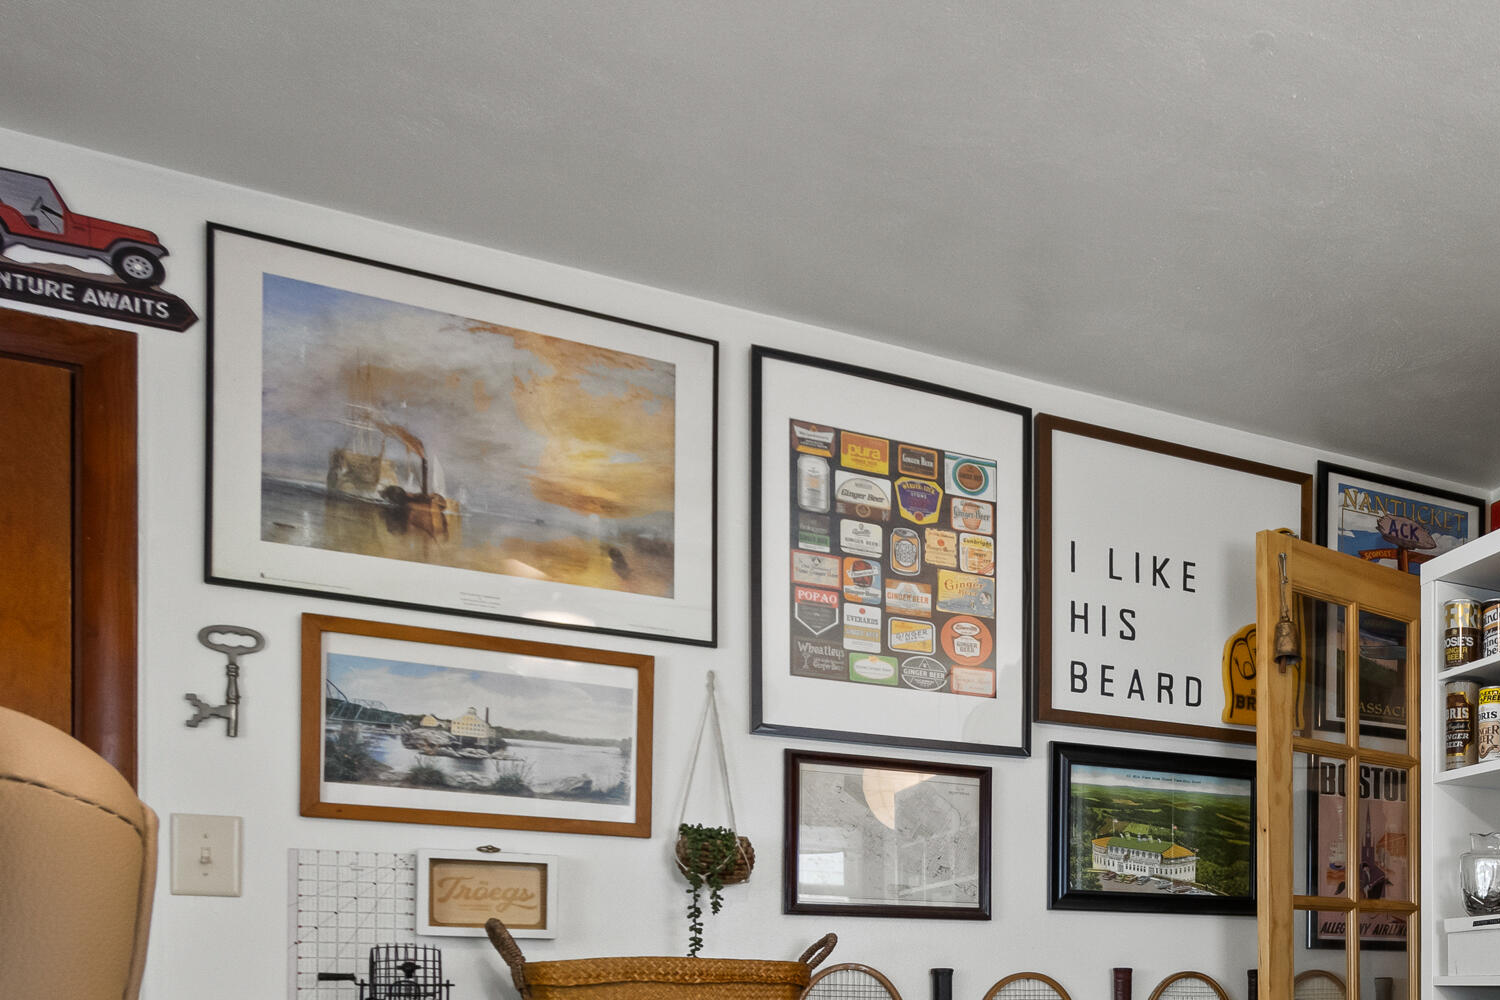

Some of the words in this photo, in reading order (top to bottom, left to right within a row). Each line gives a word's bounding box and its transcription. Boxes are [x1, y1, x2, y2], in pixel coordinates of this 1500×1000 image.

[82, 288, 170, 319] AWAITS
[1342, 488, 1465, 532] NANTUCKET
[1388, 519, 1420, 542] ACK
[1071, 541, 1075, 573] I
[1108, 548, 1196, 593] LIKE
[797, 589, 838, 604] POPAO
[1071, 601, 1136, 641] HIS
[1070, 660, 1202, 707] BEARD
